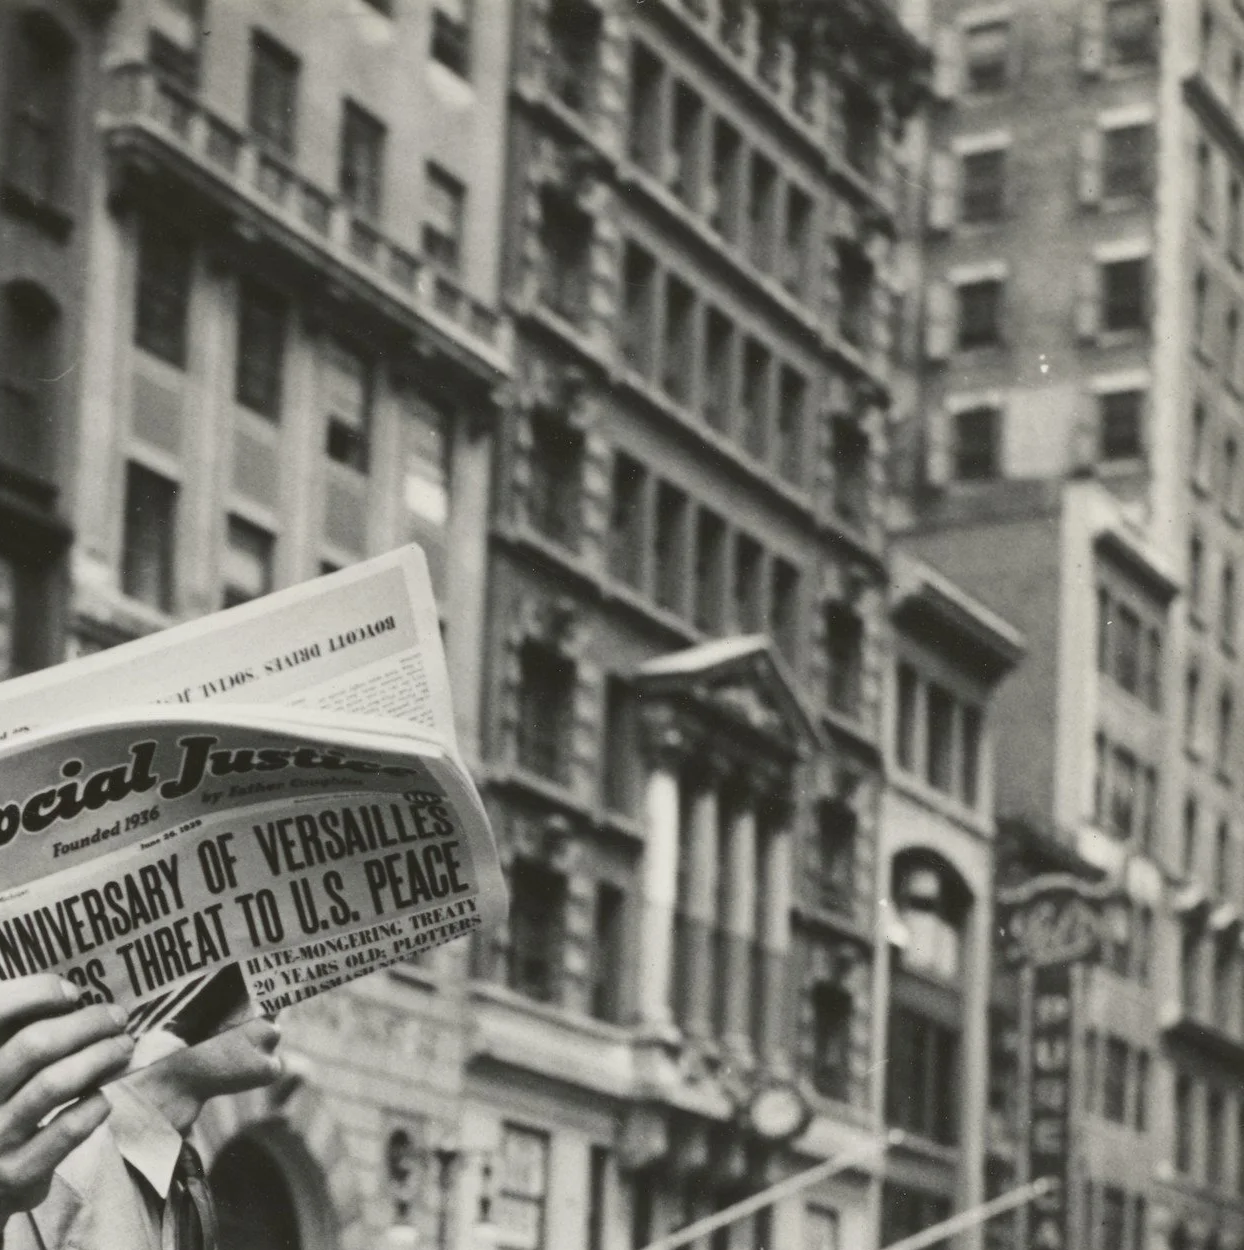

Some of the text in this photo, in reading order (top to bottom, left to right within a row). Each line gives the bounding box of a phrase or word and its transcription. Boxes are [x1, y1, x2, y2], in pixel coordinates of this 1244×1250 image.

[264, 644, 322, 673] DRIVES
[328, 615, 396, 652] BOYCOTT
[202, 789, 223, 805] by
[229, 776, 286, 797] Father
[52, 804, 161, 860] Founded 1936
[197, 832, 238, 895] OF
[252, 803, 455, 877] VERSAILLES
[115, 903, 231, 998] THREAT
[235, 887, 285, 948] TO
[289, 869, 361, 935] U.S.
[363, 841, 470, 916] PEACE
[246, 920, 404, 976] HATE-MONGERING
[408, 897, 478, 931] TREATY
[254, 977, 275, 996] 20
[279, 959, 340, 987] YEARS
[393, 914, 483, 953] PLOTTERS
